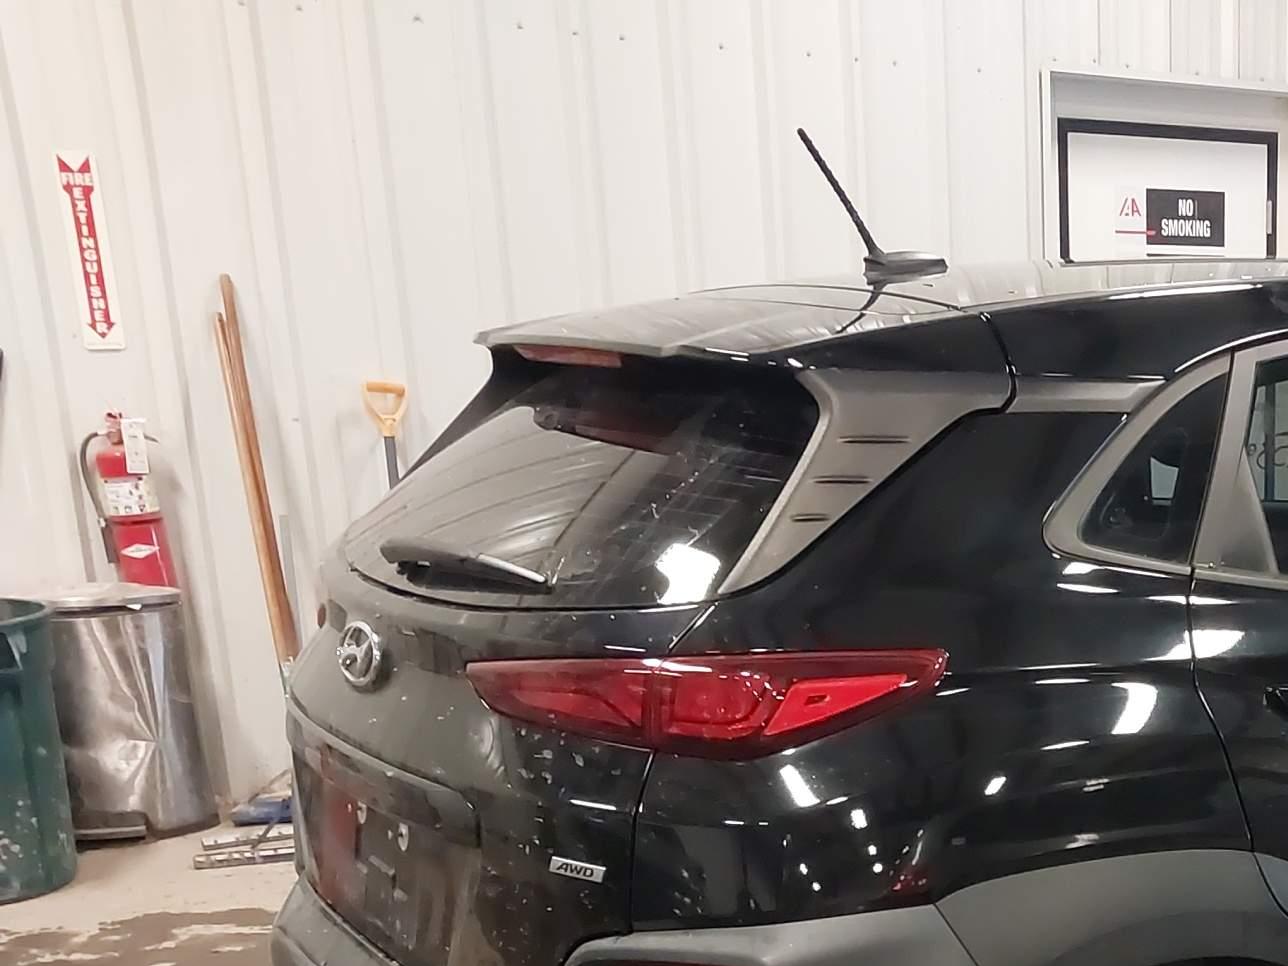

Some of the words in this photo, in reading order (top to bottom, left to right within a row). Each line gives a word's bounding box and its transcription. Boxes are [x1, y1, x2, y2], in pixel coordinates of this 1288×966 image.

[61, 172, 94, 187] FIRE
[1178, 198, 1194, 216] NO
[1161, 218, 1211, 238] SMOKING
[71, 187, 110, 334] EXTINGUISHER
[556, 862, 594, 878] AWD
